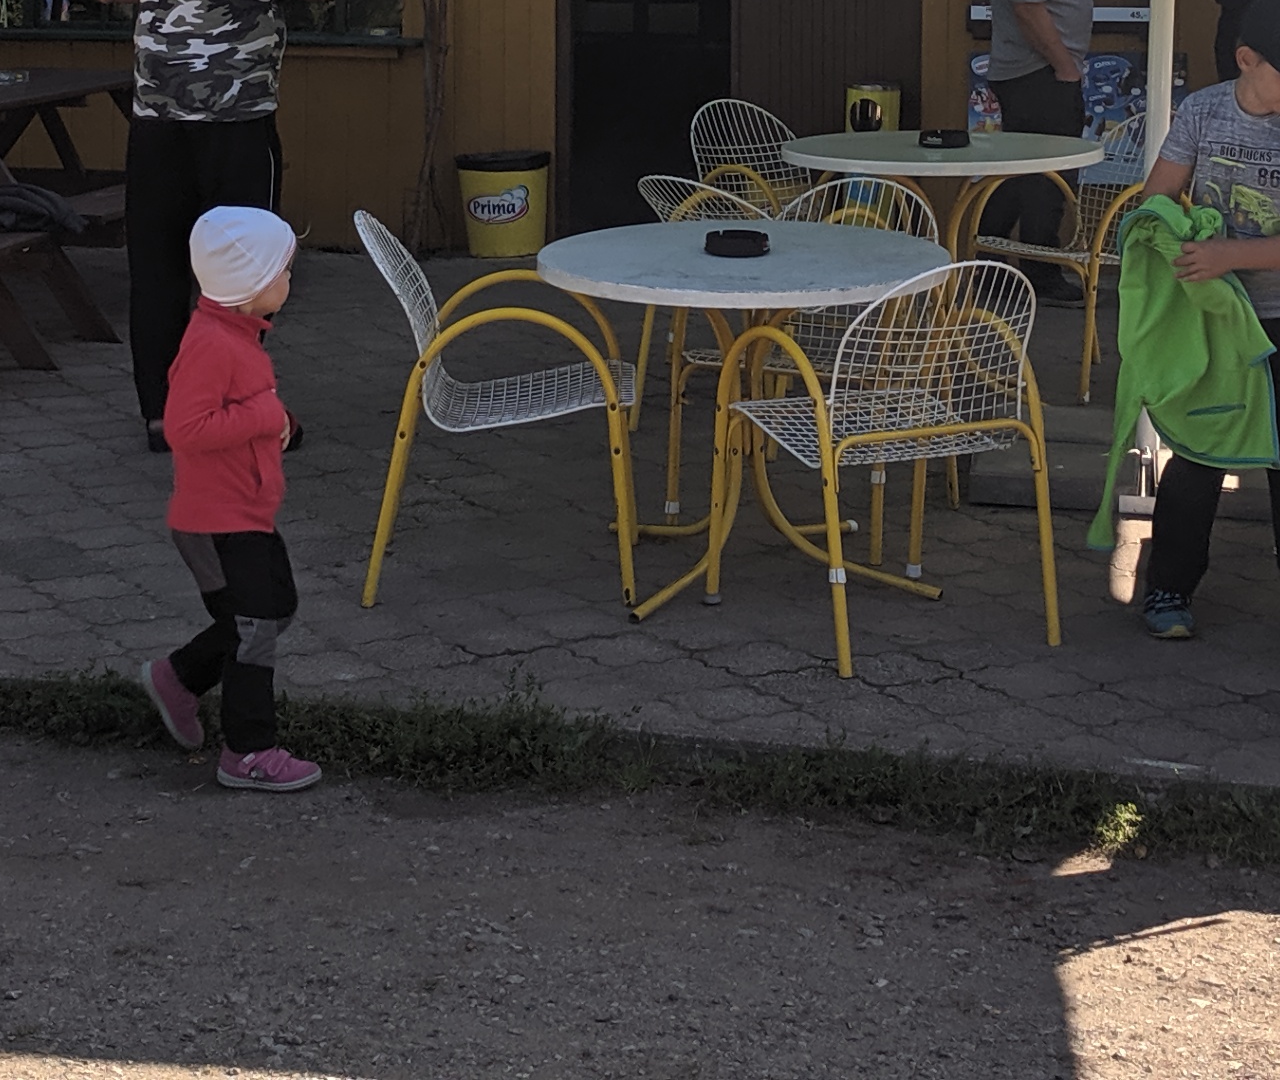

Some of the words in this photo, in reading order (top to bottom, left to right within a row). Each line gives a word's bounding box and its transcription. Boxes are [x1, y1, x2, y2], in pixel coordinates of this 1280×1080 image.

[1219, 145, 1237, 158] BIG
[1258, 167, 1280, 188] 86
[473, 199, 516, 215] Prima
